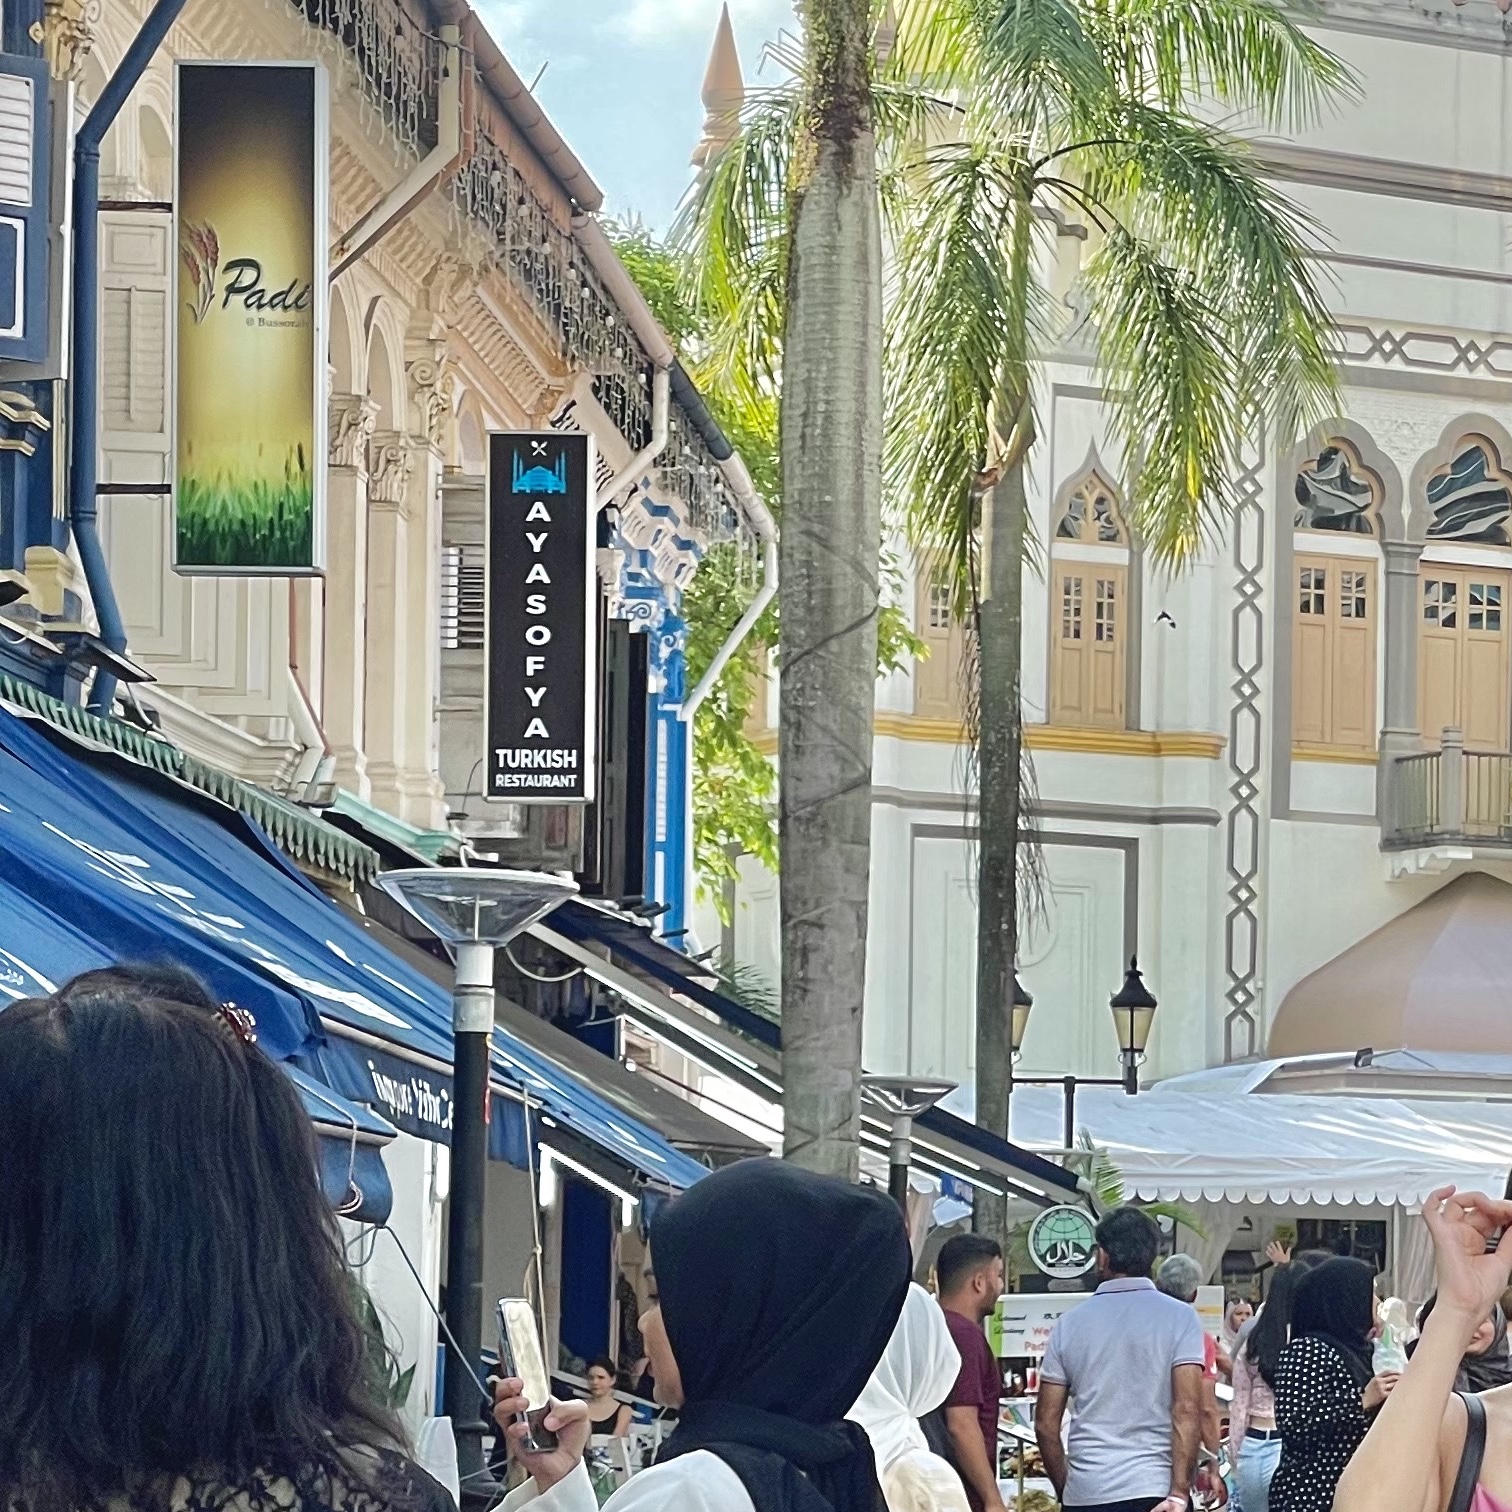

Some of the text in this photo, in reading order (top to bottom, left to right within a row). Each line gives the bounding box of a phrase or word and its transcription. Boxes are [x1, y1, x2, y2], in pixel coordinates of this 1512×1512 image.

[221, 258, 312, 311] Padi
[523, 501, 552, 739] AYASOFYA
[496, 748, 578, 769] TURKISH
[496, 774, 578, 789] RESTAURANT
[1046, 1239, 1086, 1264] حلال
